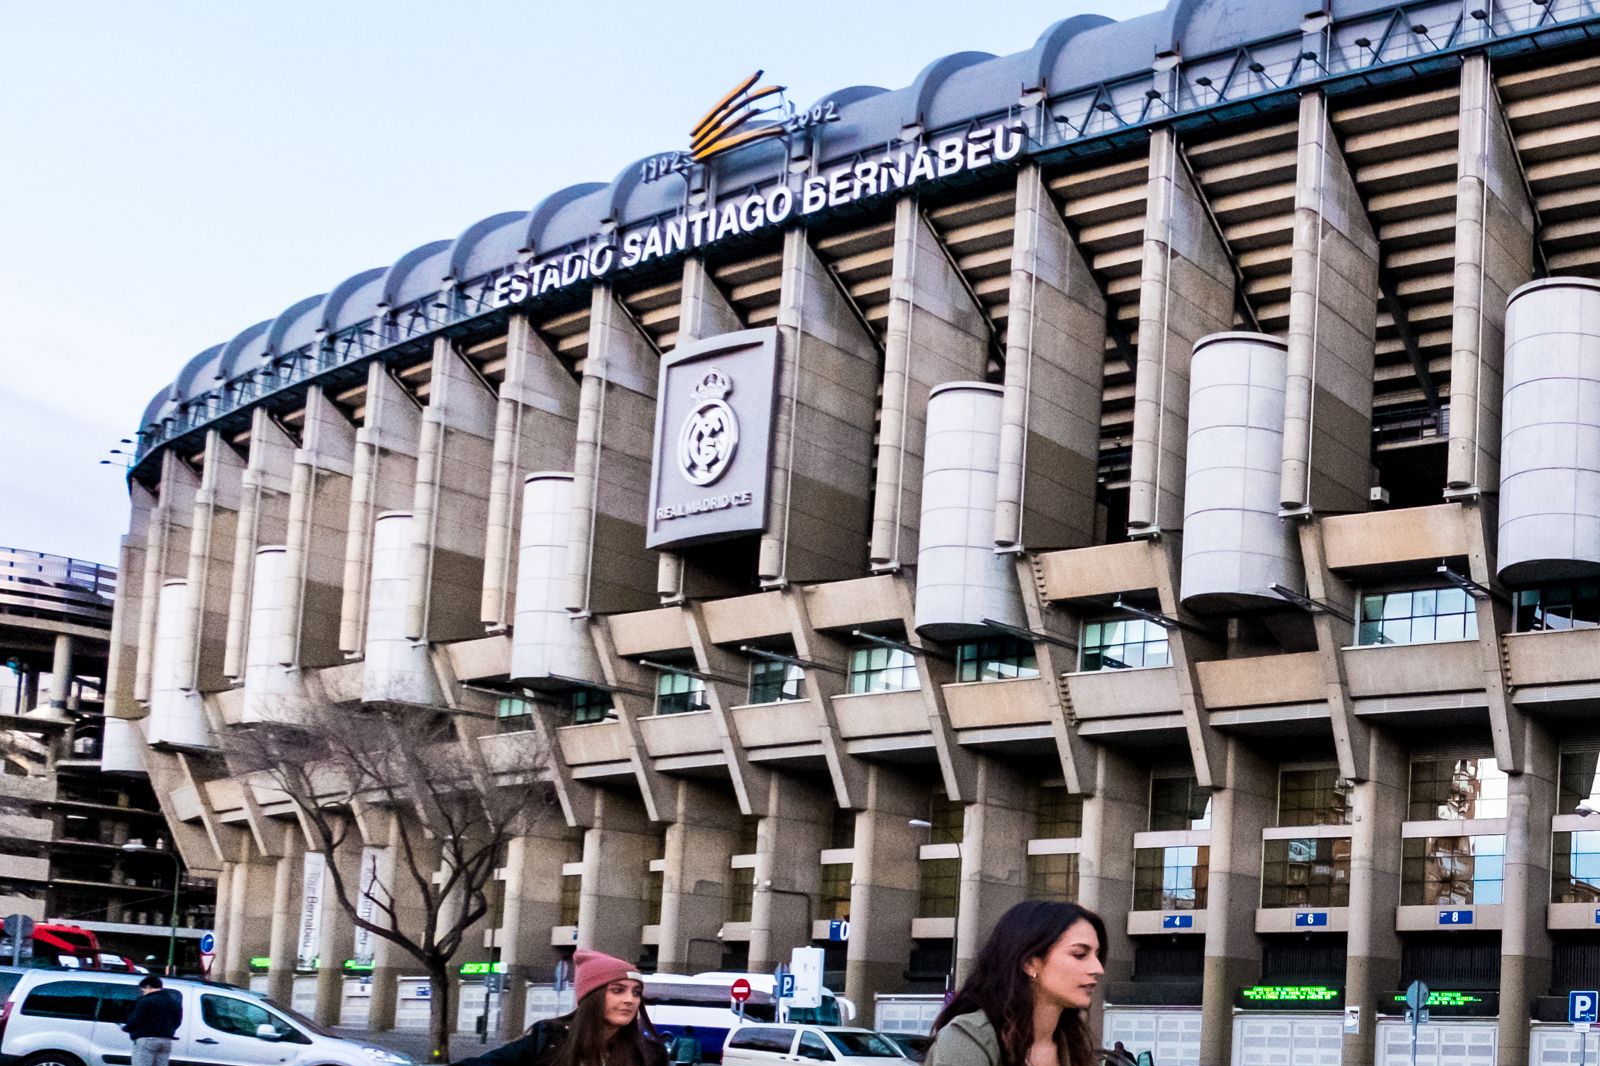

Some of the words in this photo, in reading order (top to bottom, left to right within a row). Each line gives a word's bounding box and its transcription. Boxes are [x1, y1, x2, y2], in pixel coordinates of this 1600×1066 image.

[640, 151, 682, 183] 1902
[492, 241, 613, 309] ESTADIO
[621, 185, 793, 268] SANTIAGO
[802, 119, 1027, 216] BERNABEU
[656, 504, 687, 520] REAL
[687, 497, 733, 516] MADRID
[303, 896, 318, 948] Bernabeu
[1174, 916, 1180, 926] 4
[1307, 913, 1314, 925] 6
[1451, 911, 1459, 923] 8
[783, 977, 792, 994] P
[1575, 995, 1592, 1019] P
